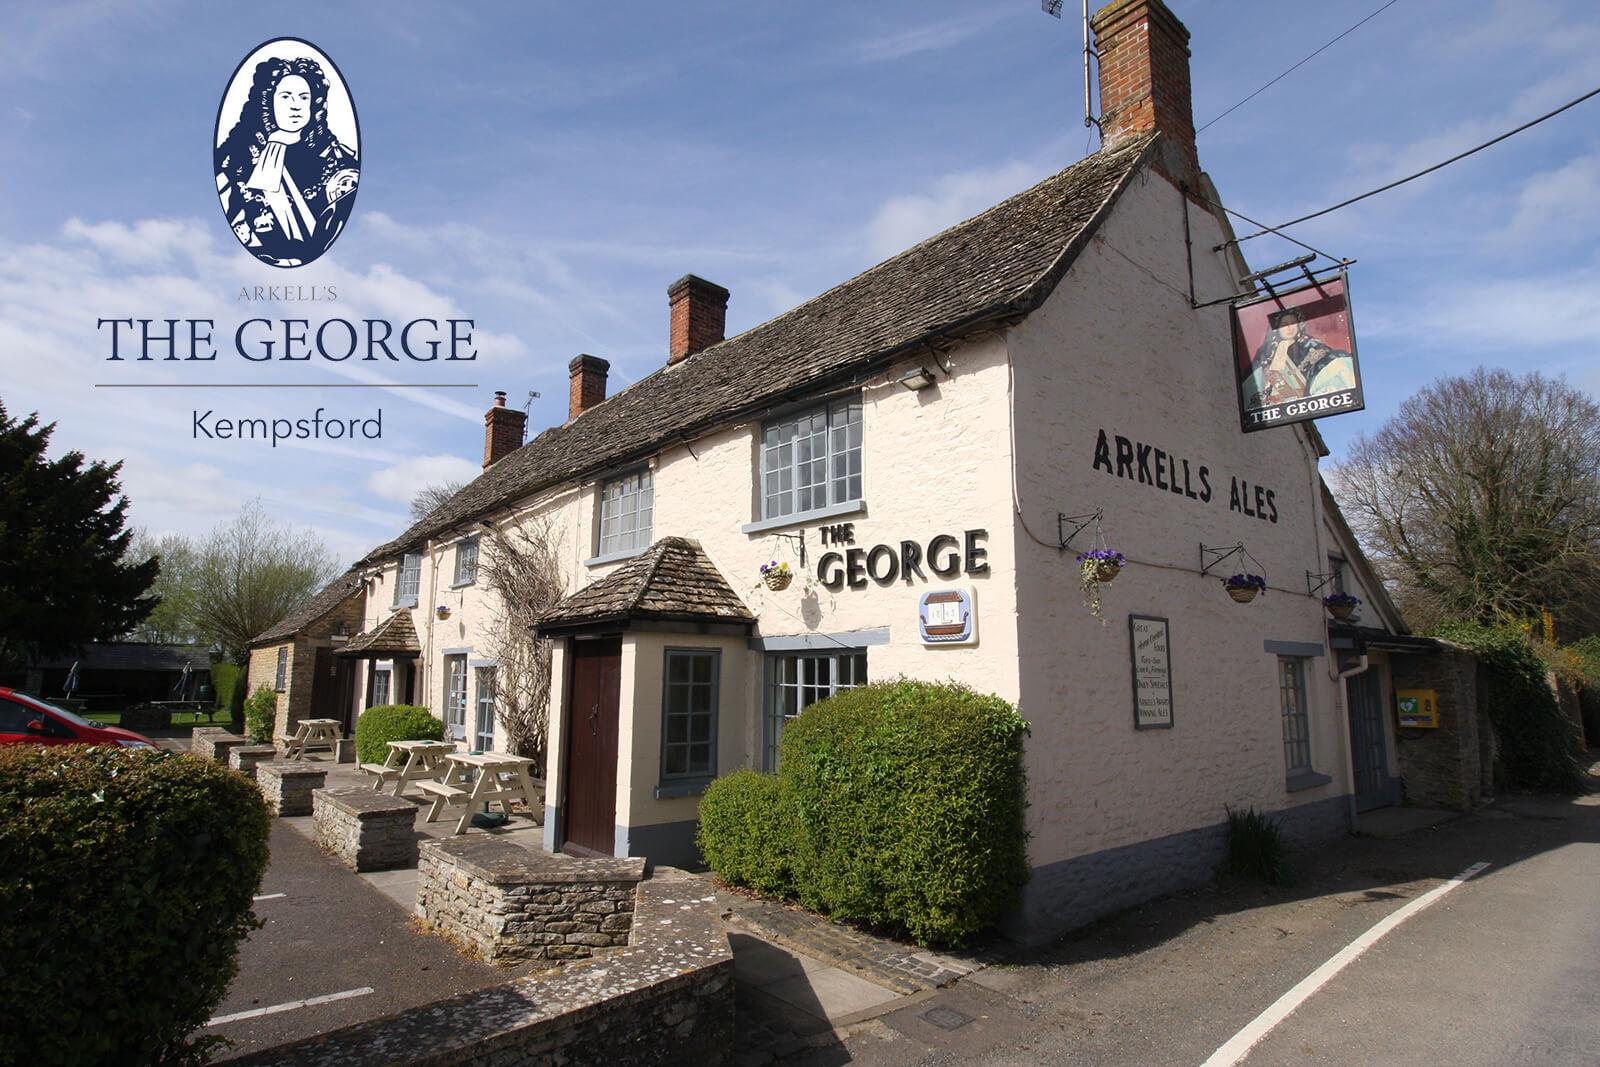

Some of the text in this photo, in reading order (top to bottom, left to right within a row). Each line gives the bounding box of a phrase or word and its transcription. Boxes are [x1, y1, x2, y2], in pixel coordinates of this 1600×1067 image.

[1250, 392, 1353, 423] THE GEORGE
[1093, 428, 1278, 523] ARKELLS ALES
[817, 523, 990, 587] THE GEORGE
